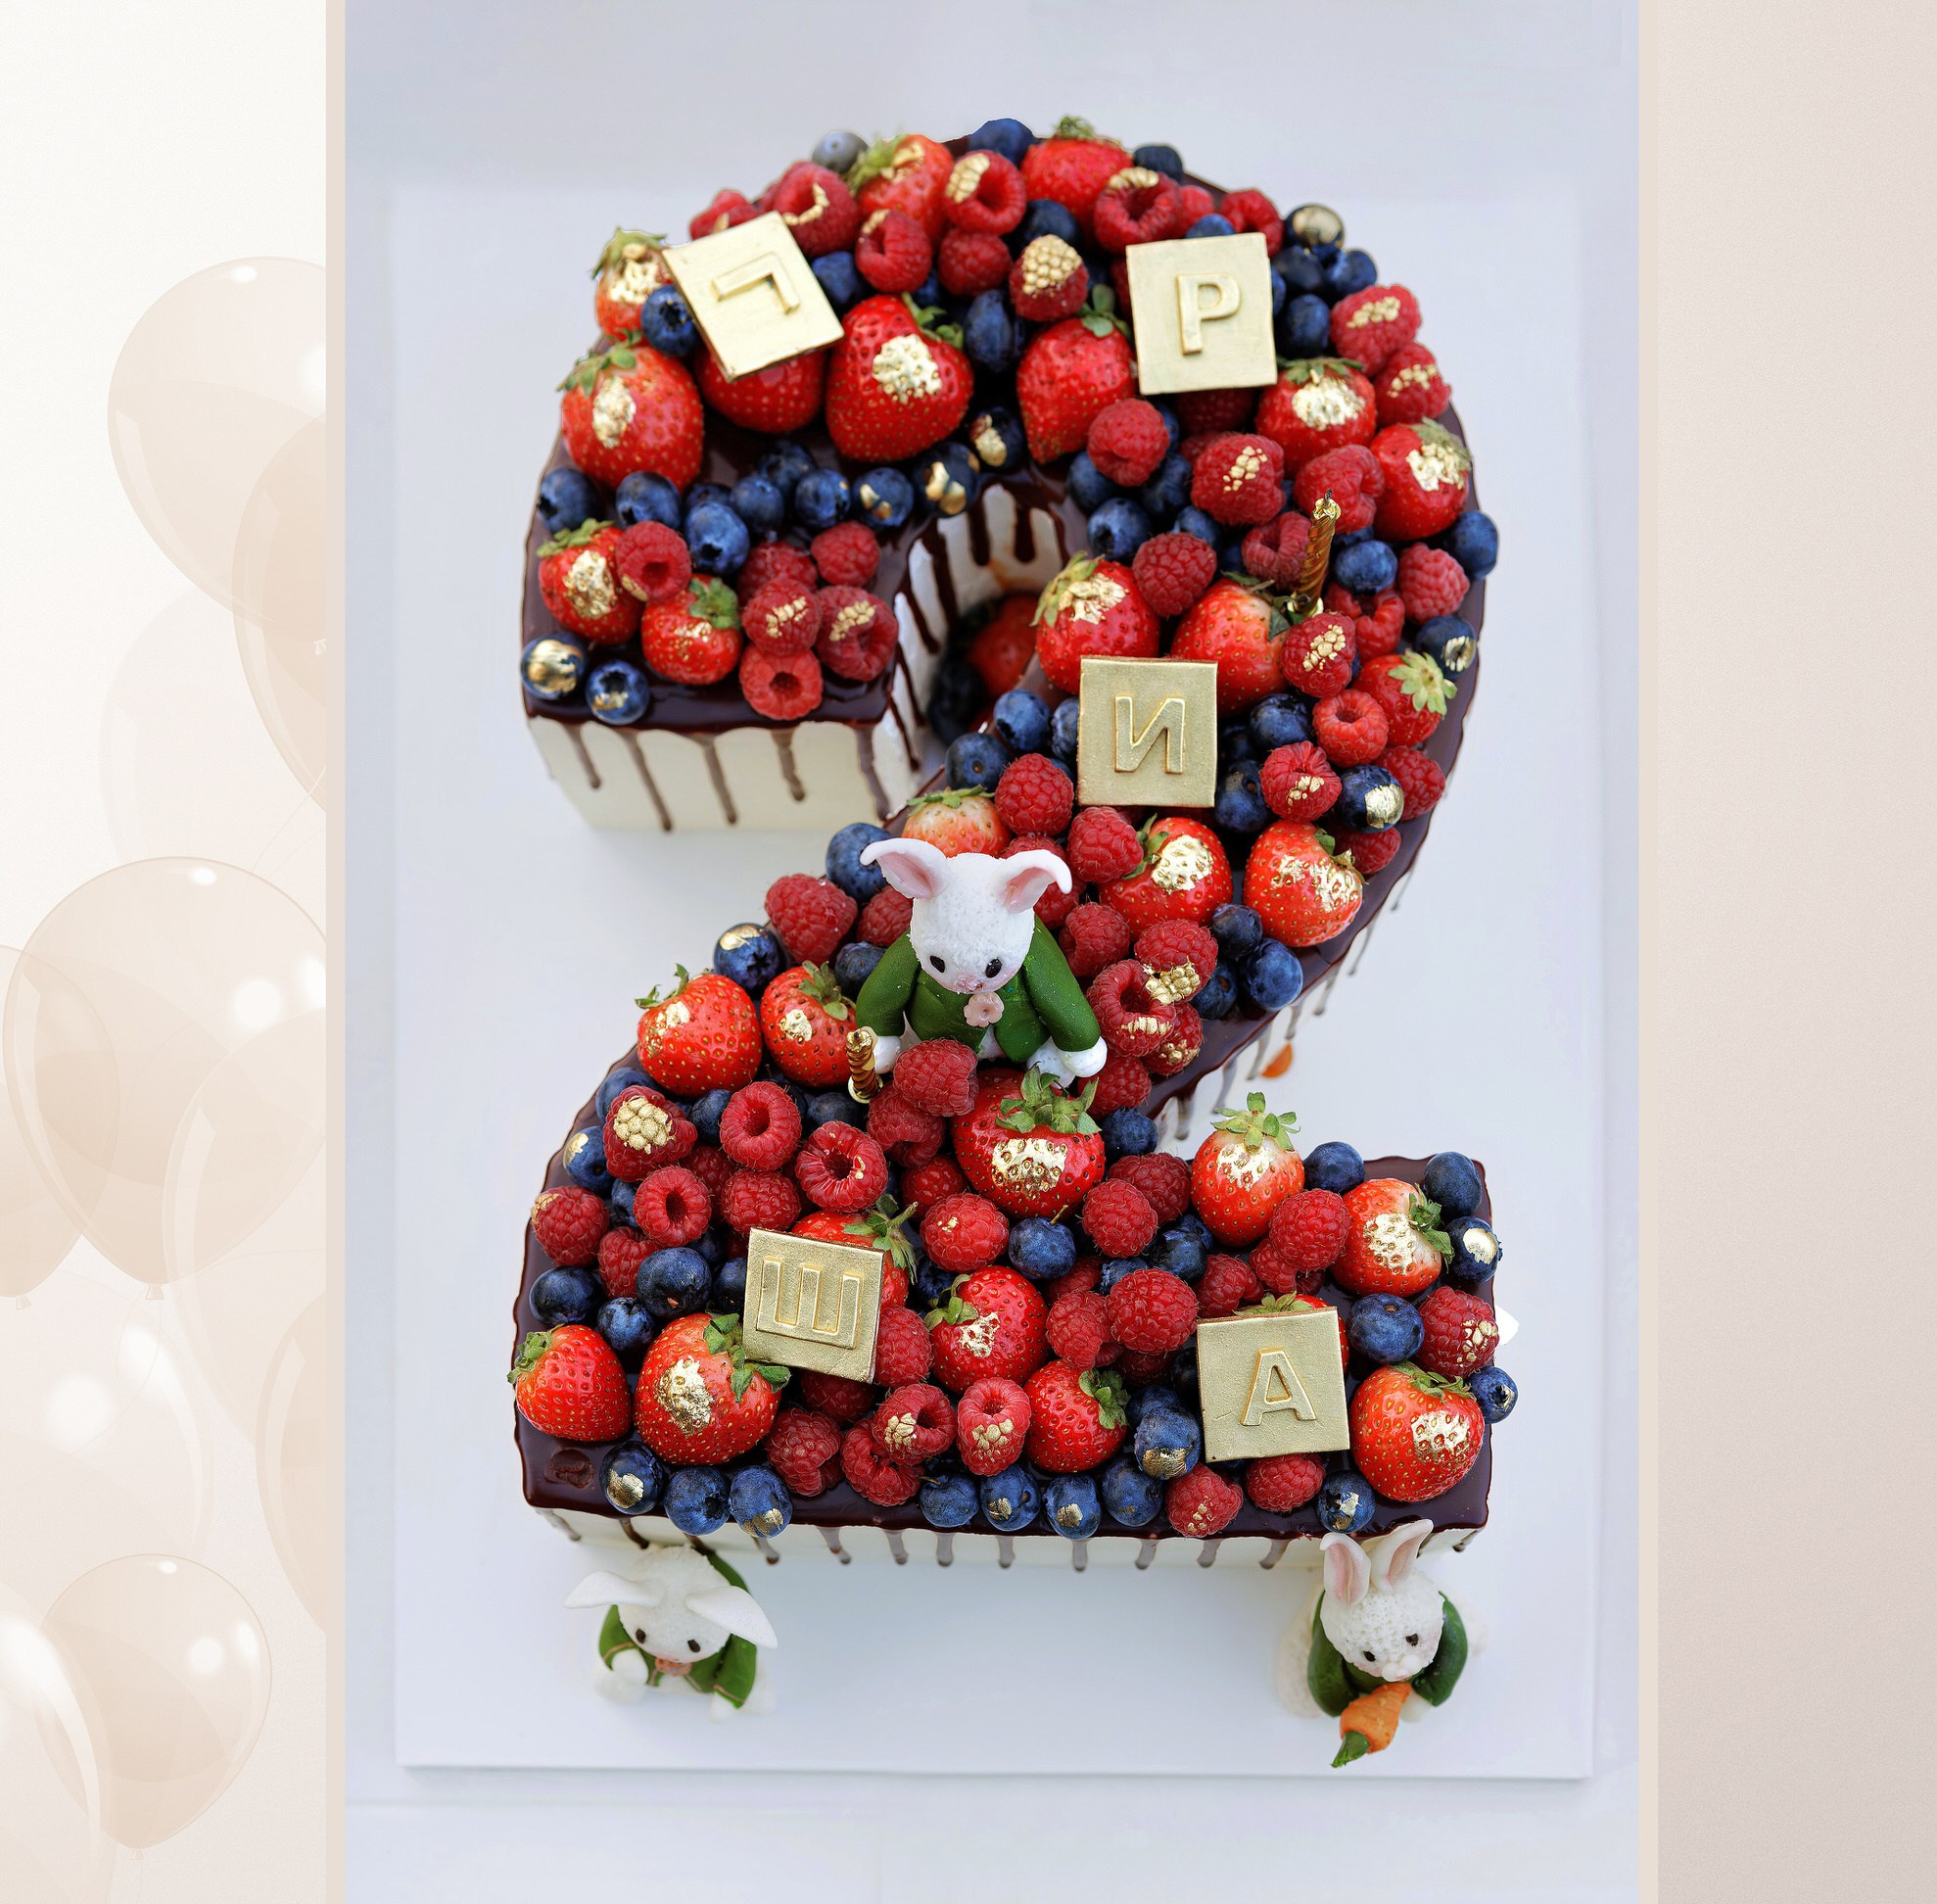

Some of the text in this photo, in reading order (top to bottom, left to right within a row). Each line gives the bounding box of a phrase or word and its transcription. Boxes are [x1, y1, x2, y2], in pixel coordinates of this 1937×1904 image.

[1176, 273, 1242, 356] Р
[1113, 693, 1186, 775] И
[755, 1256, 864, 1350] Ш
[1240, 1347, 1317, 1426] А
